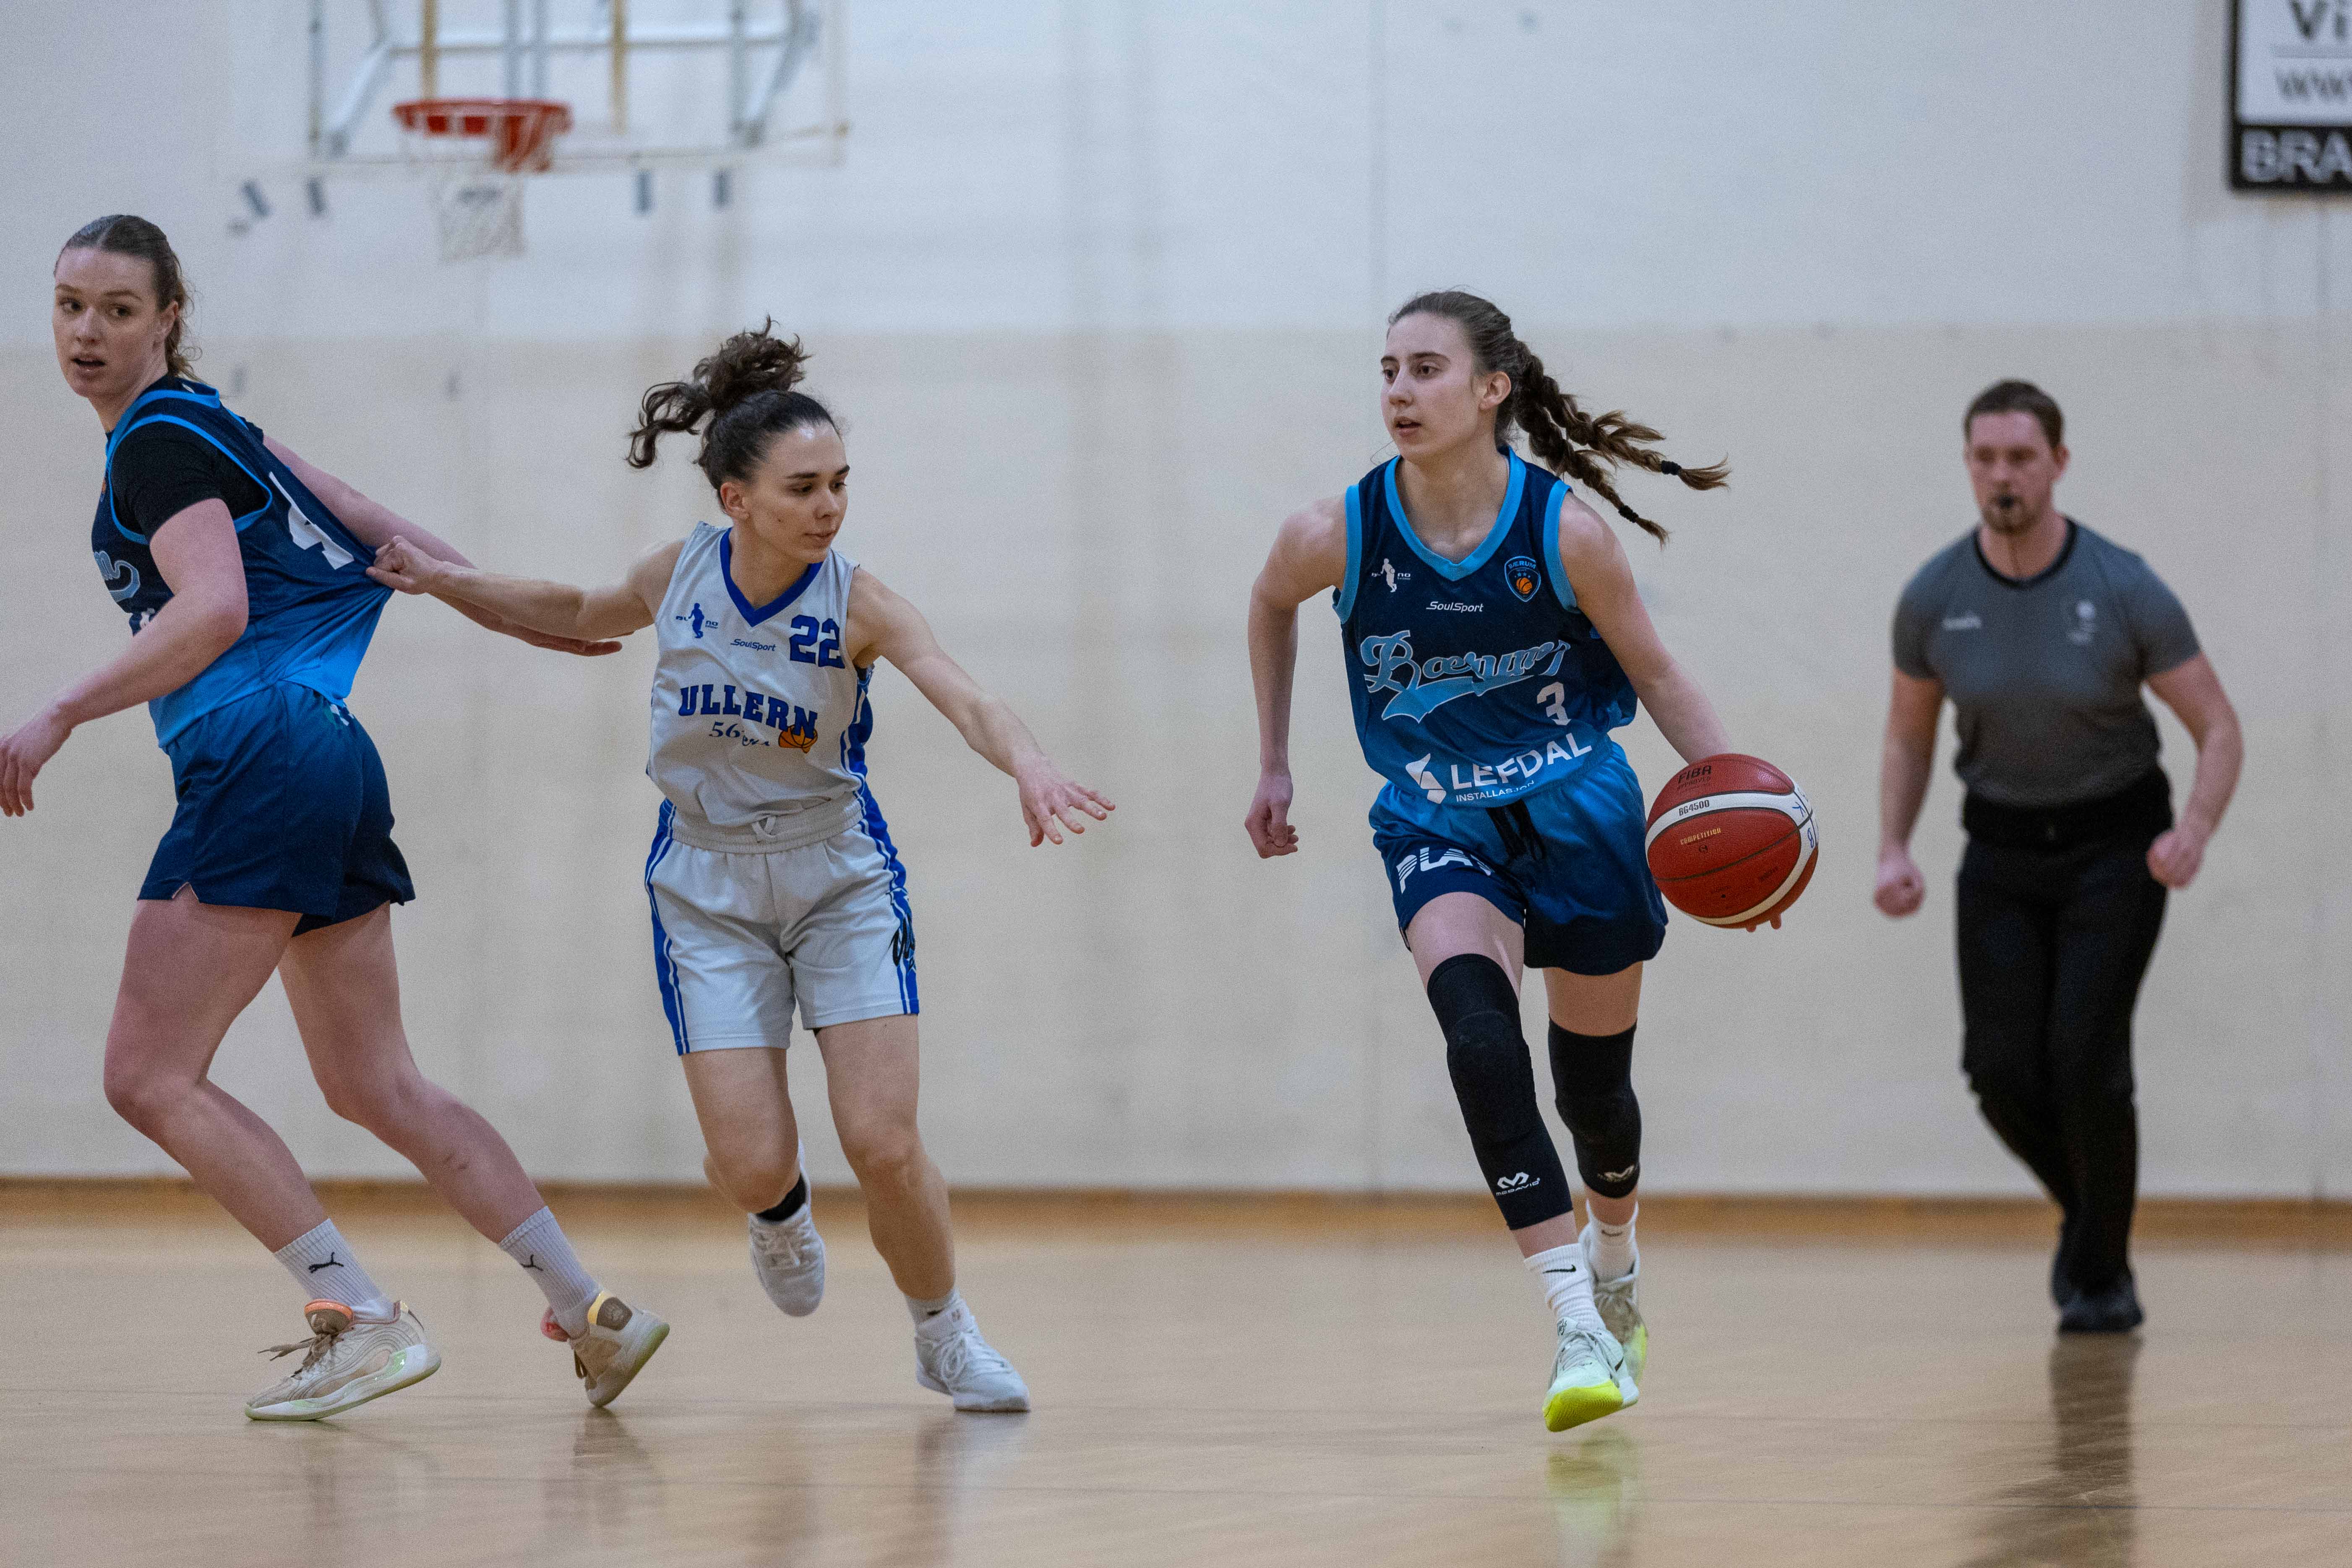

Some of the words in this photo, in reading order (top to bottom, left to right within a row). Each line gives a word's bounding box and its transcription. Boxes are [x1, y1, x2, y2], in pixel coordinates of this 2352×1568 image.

[1426, 601, 1484, 613] SoulSport
[730, 639, 776, 651] SoulSport
[790, 615, 845, 668] 22
[678, 684, 818, 739] ULLERN
[1537, 682, 1571, 725] 3
[1451, 733, 1592, 790] LEFDAL
[1678, 765, 1711, 783] FIBA
[1456, 780, 1534, 802] INSTALLASJON
[1679, 800, 1710, 816] BG4500
[1680, 827, 1721, 845] COMPETITION
